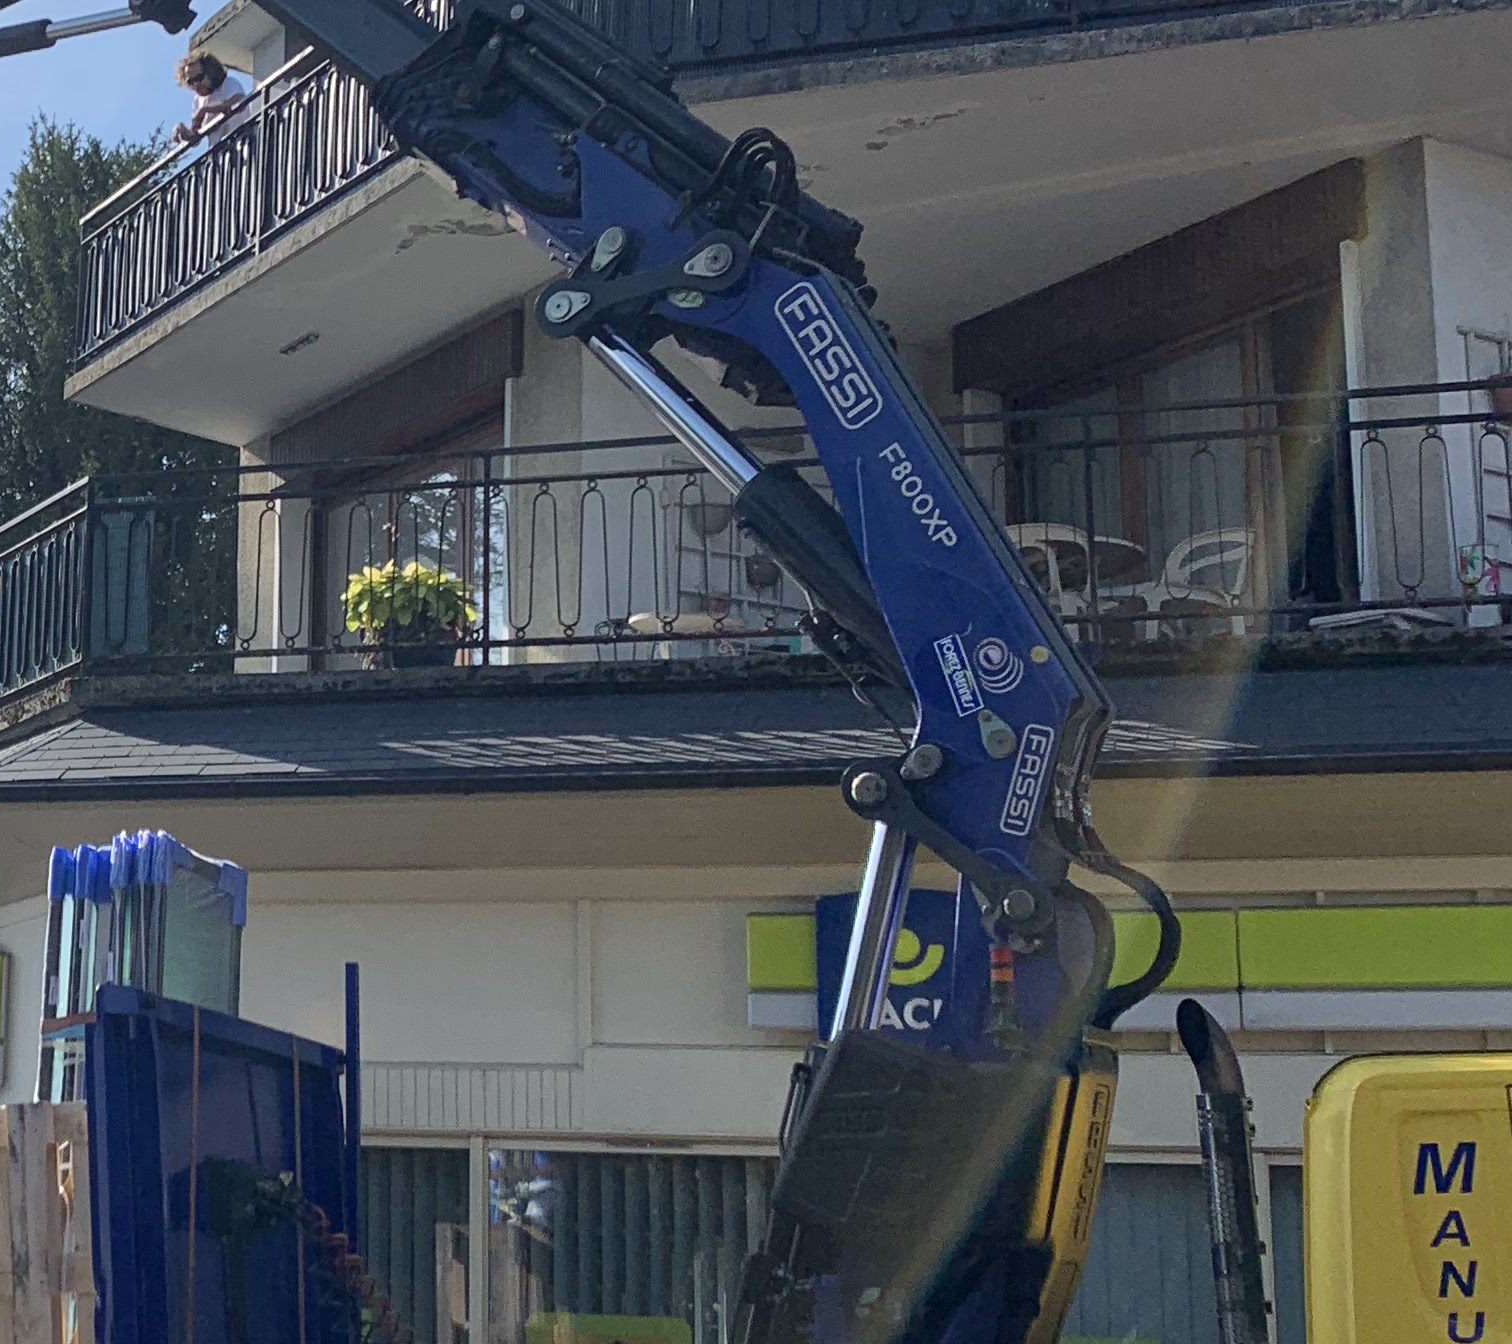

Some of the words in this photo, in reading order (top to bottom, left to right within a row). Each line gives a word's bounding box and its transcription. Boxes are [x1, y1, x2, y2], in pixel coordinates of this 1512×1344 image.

[783, 293, 874, 419] FASSI
[879, 442, 958, 547] F800XP
[1007, 733, 1047, 827] FASSI
